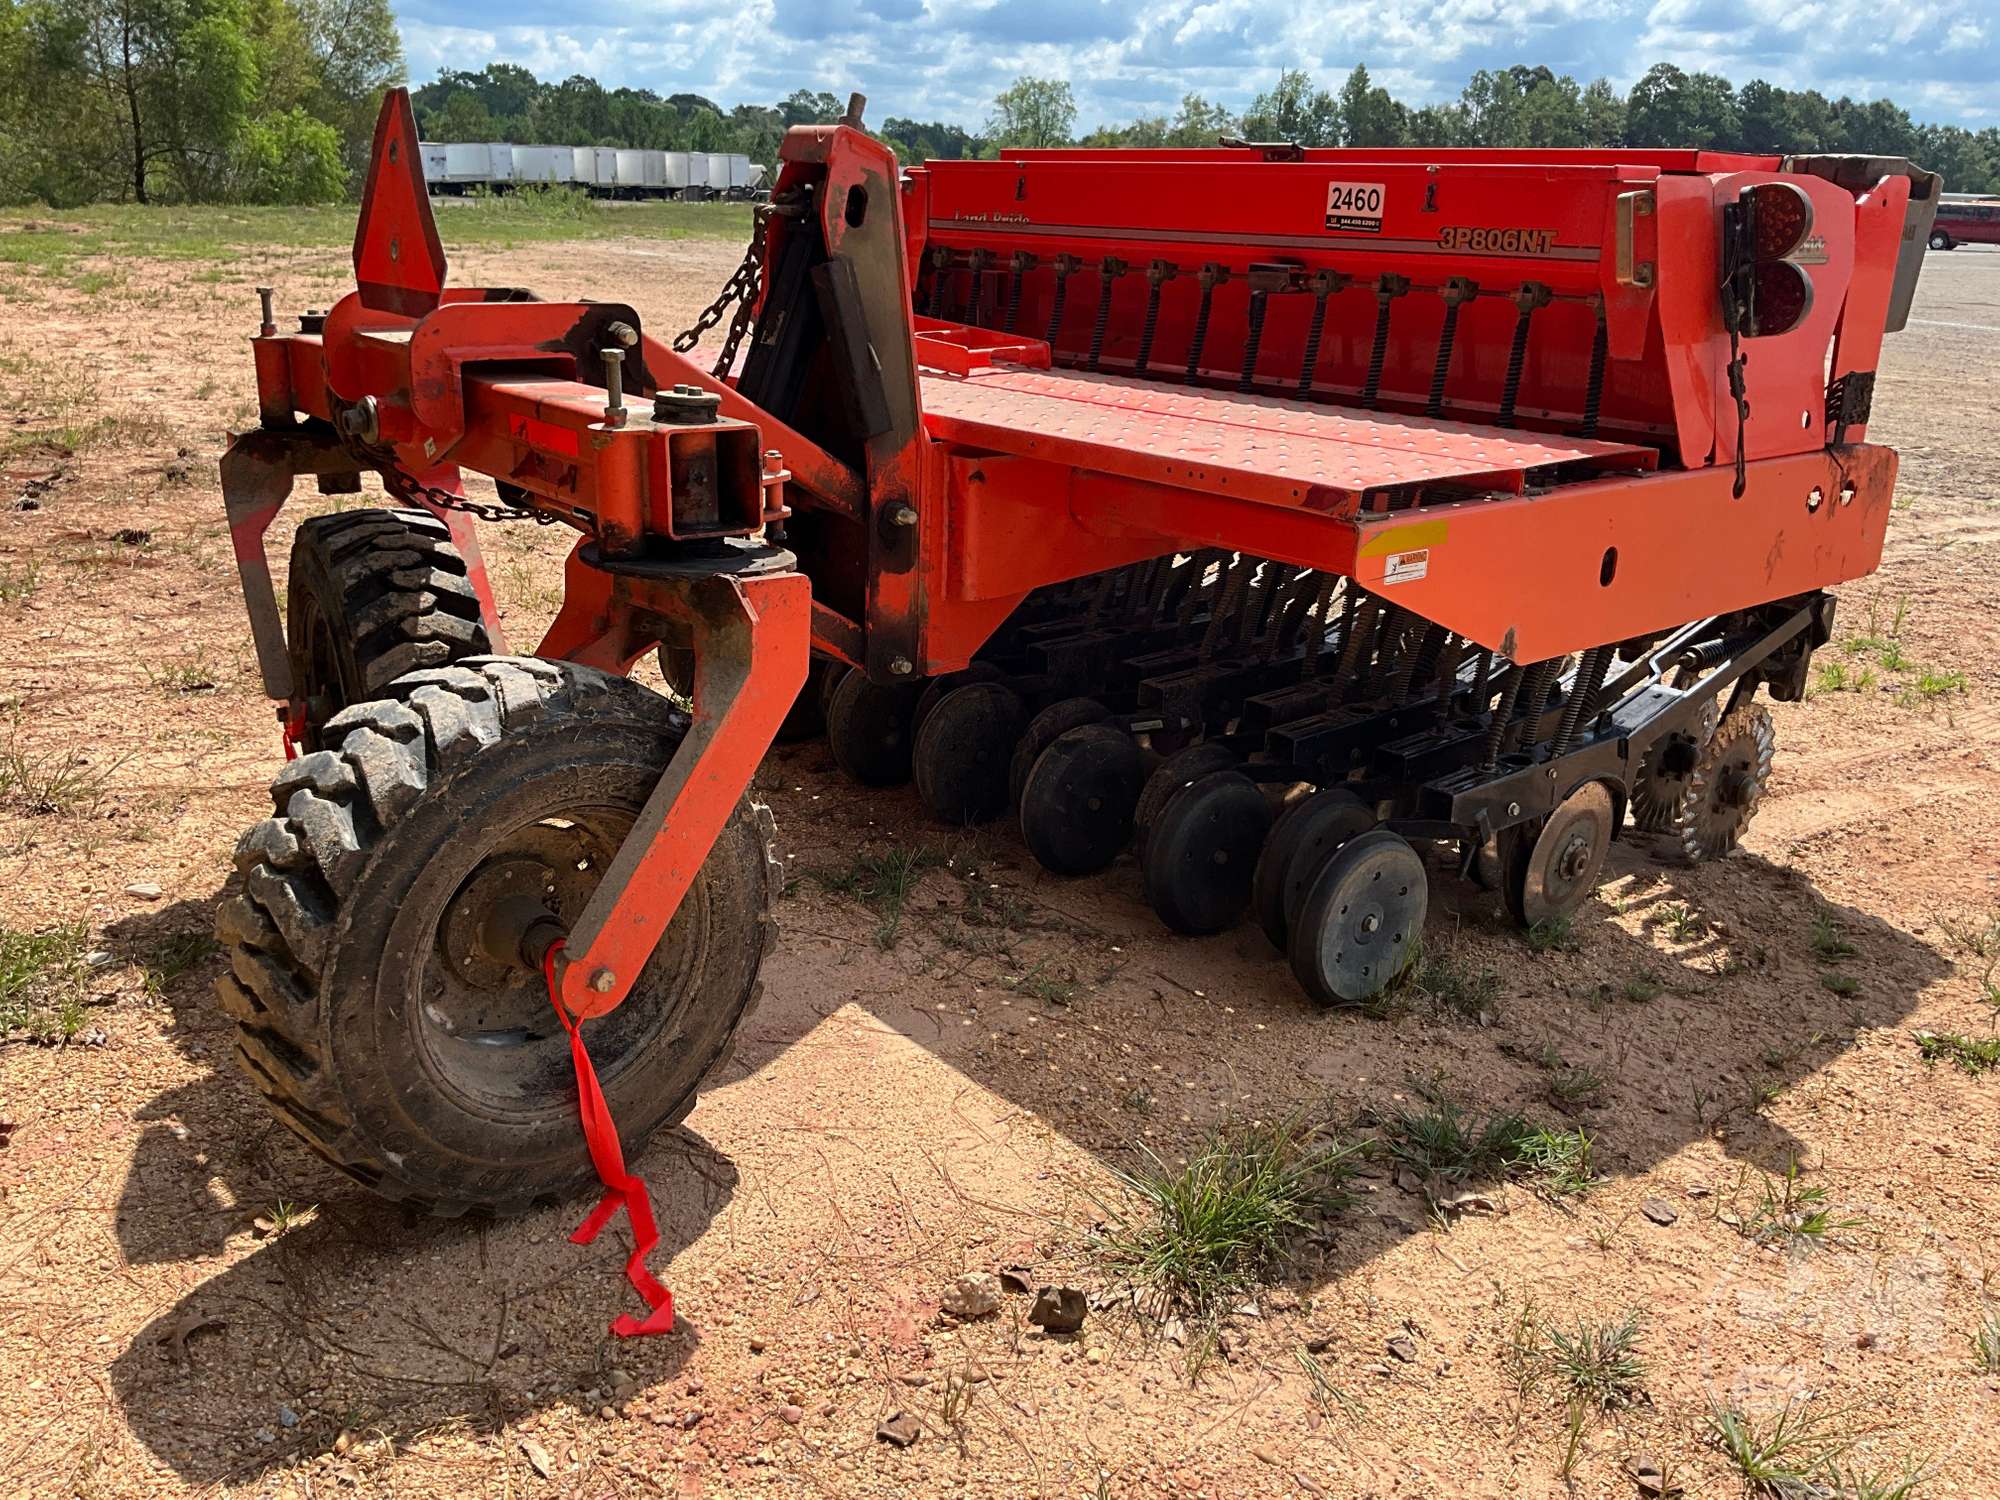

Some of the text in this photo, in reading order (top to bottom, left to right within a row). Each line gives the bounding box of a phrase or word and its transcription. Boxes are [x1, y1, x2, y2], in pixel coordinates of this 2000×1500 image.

[1330, 186, 1380, 212] 2460
[954, 209, 987, 222] Land
[1438, 226, 1558, 254] 3P806NT
